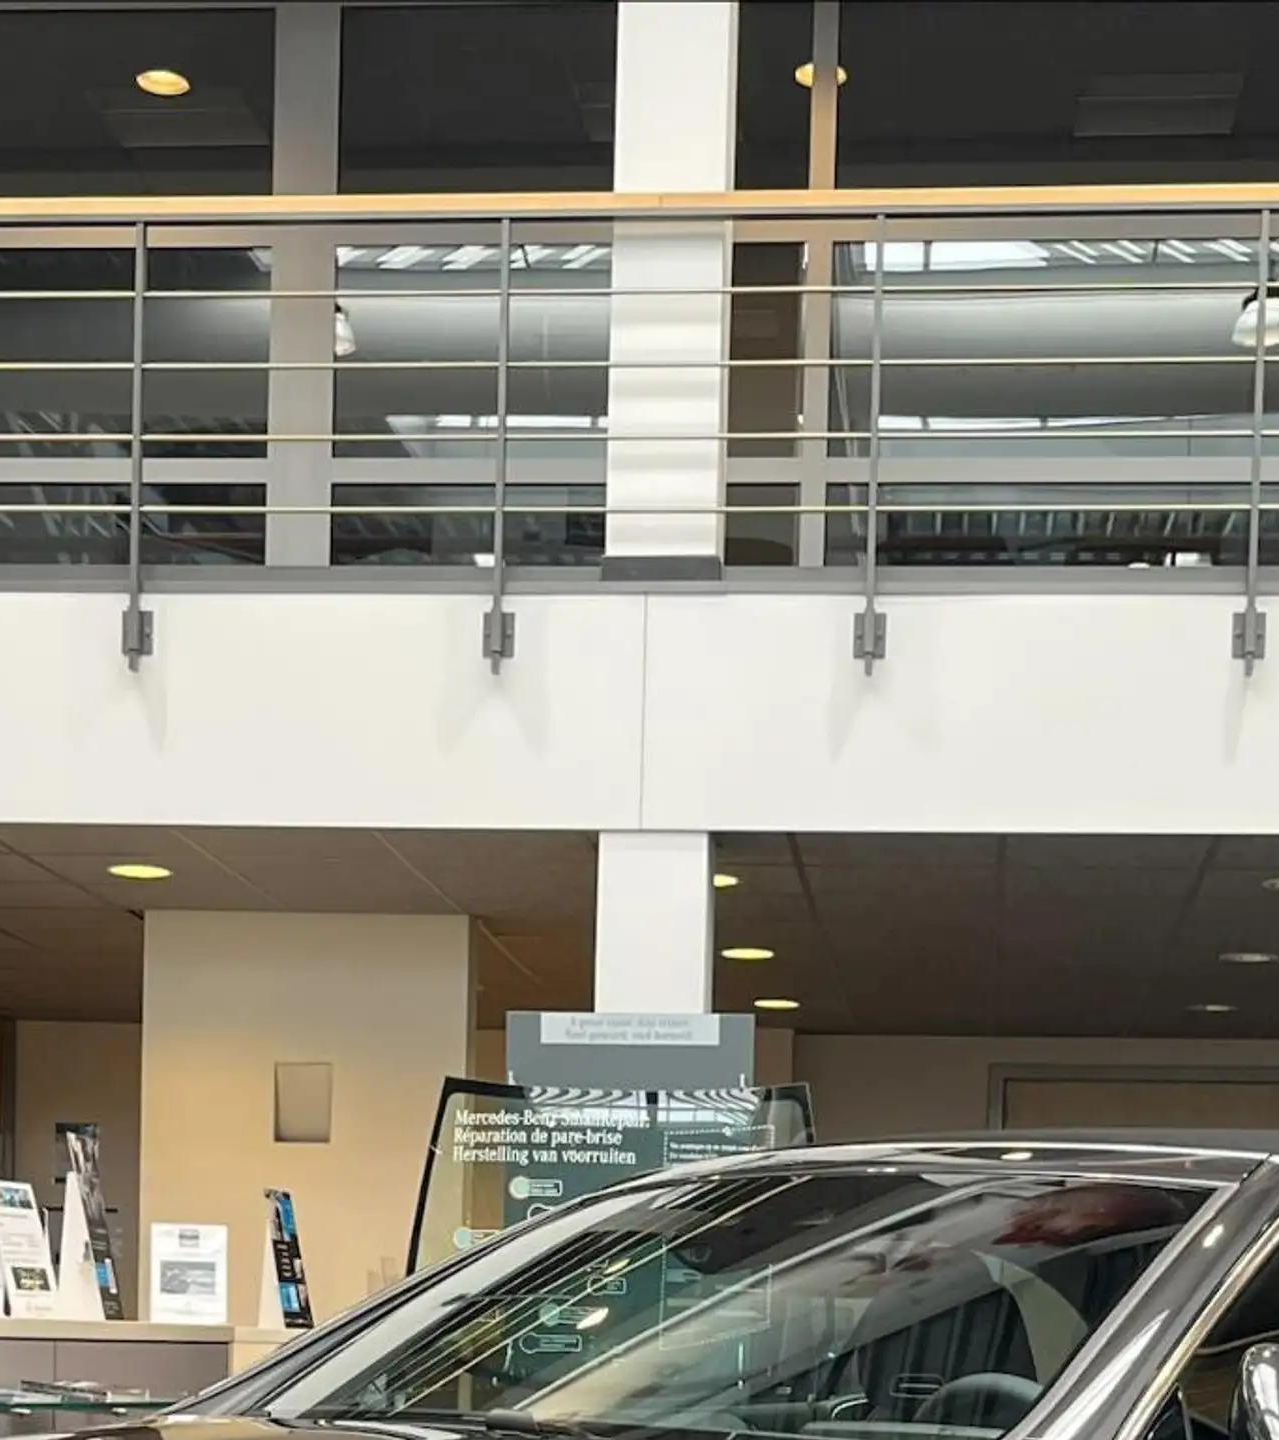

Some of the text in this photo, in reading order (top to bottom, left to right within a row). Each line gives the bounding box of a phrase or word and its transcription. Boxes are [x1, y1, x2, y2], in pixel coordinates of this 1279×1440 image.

[454, 1109, 555, 1128] Mercedes-Benz
[453, 1128, 623, 1147] Réparation de pare-brise
[453, 1146, 636, 1166] Herstelling van voorruiten
